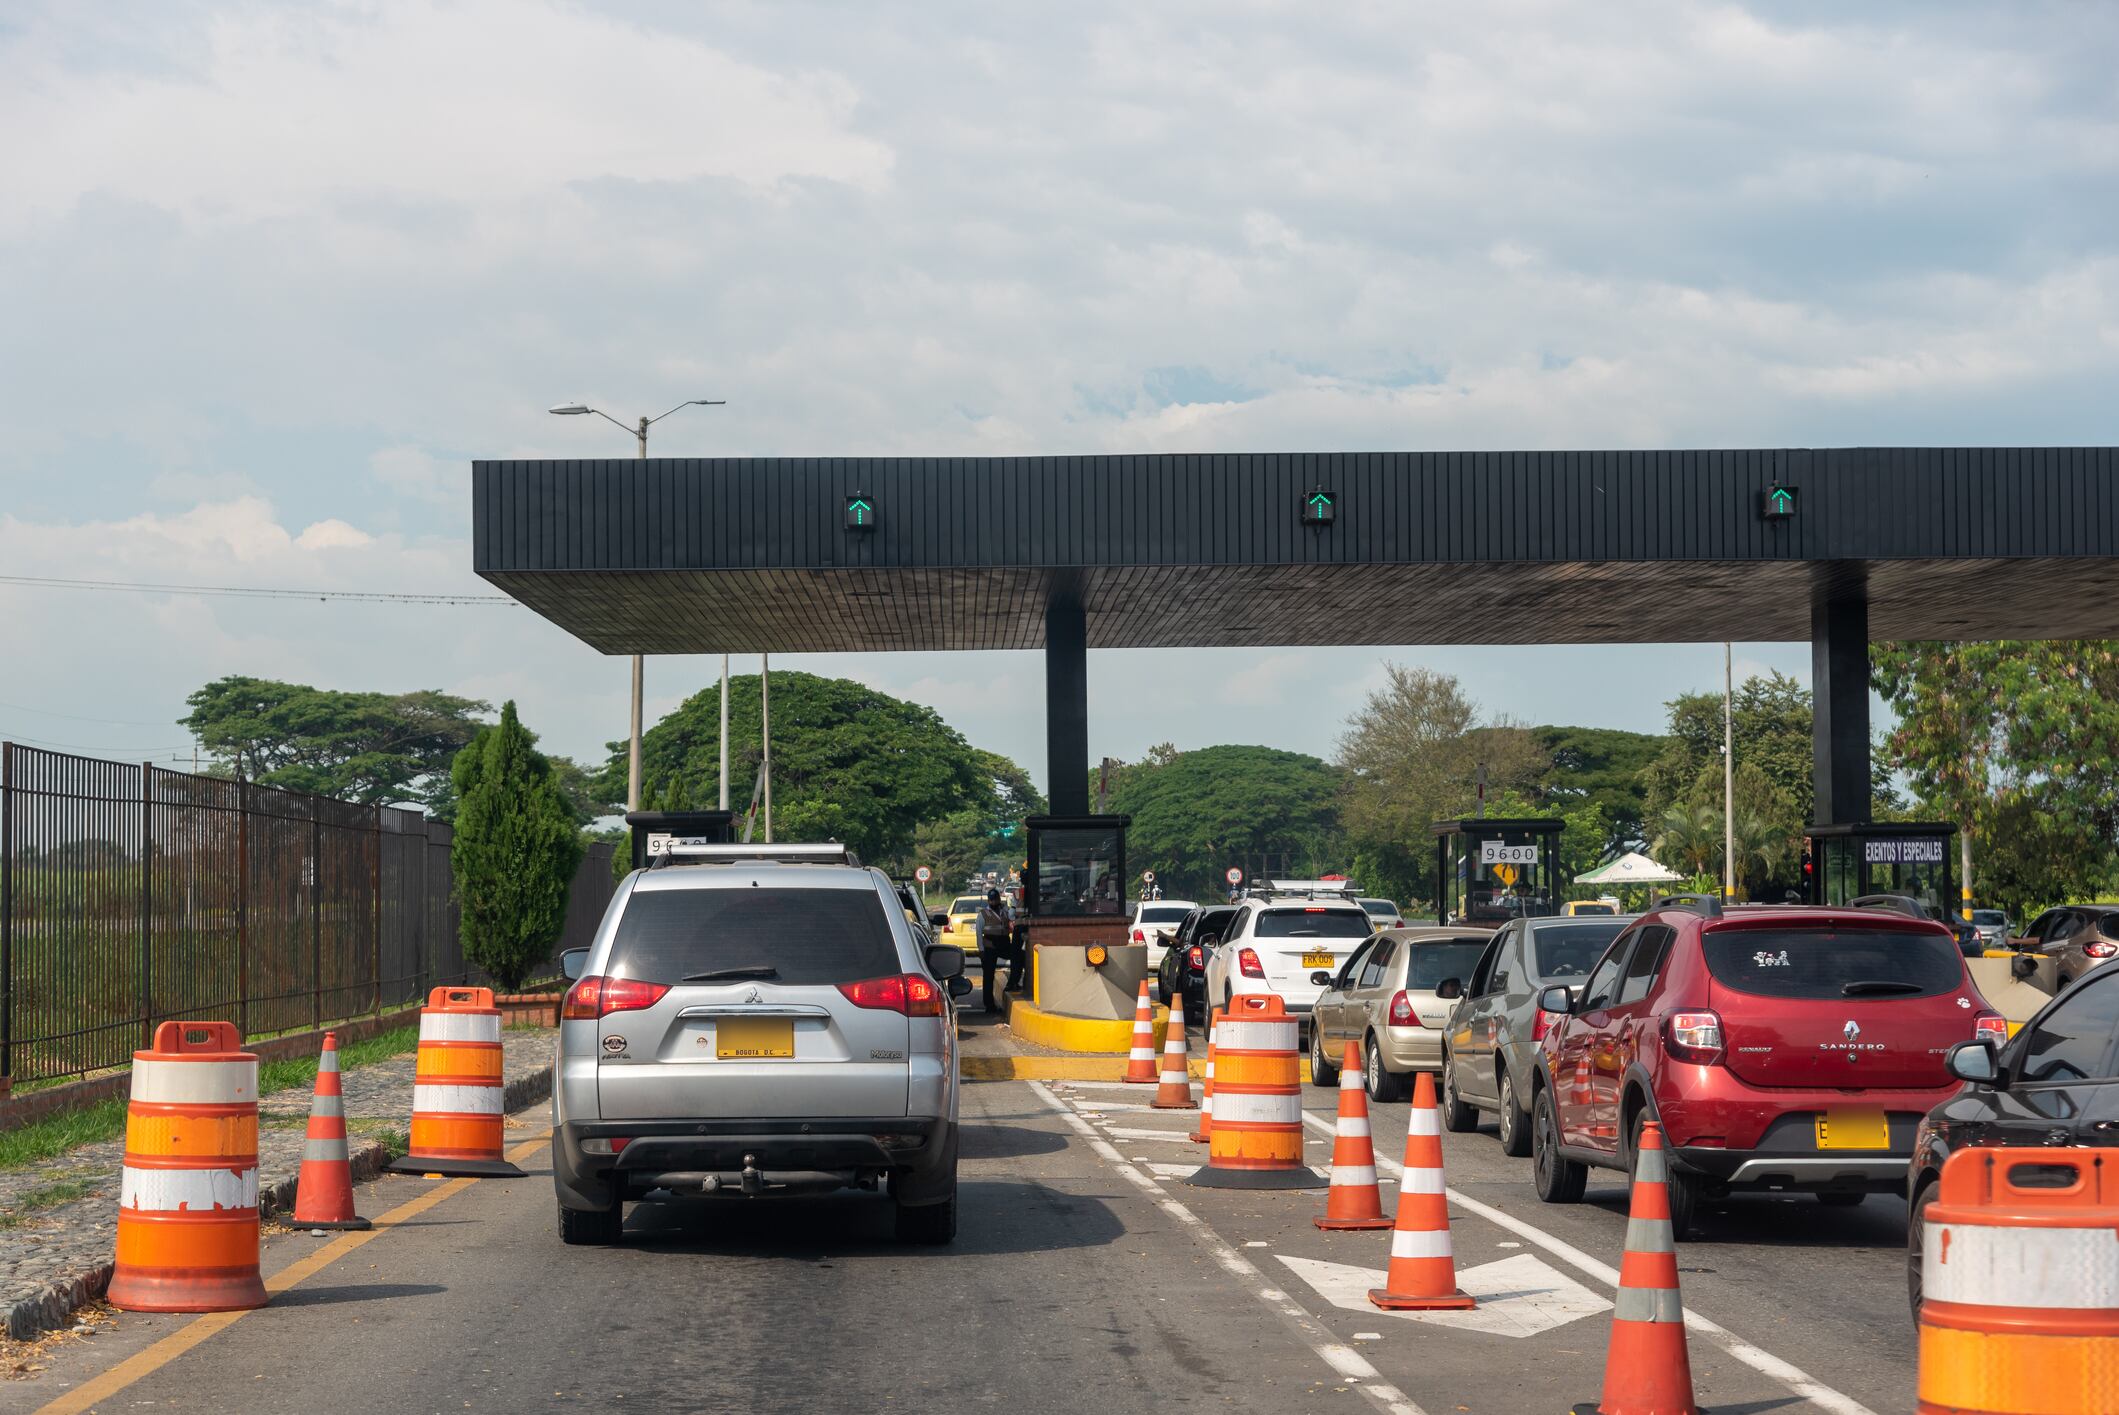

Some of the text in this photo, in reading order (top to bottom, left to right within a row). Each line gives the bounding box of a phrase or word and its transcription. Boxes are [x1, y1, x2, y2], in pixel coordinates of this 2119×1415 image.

[1486, 848, 1533, 860] 9600
[1865, 841, 1943, 861] EXENTOS Y ESPECIALES
[1303, 954, 1317, 964] FRK
